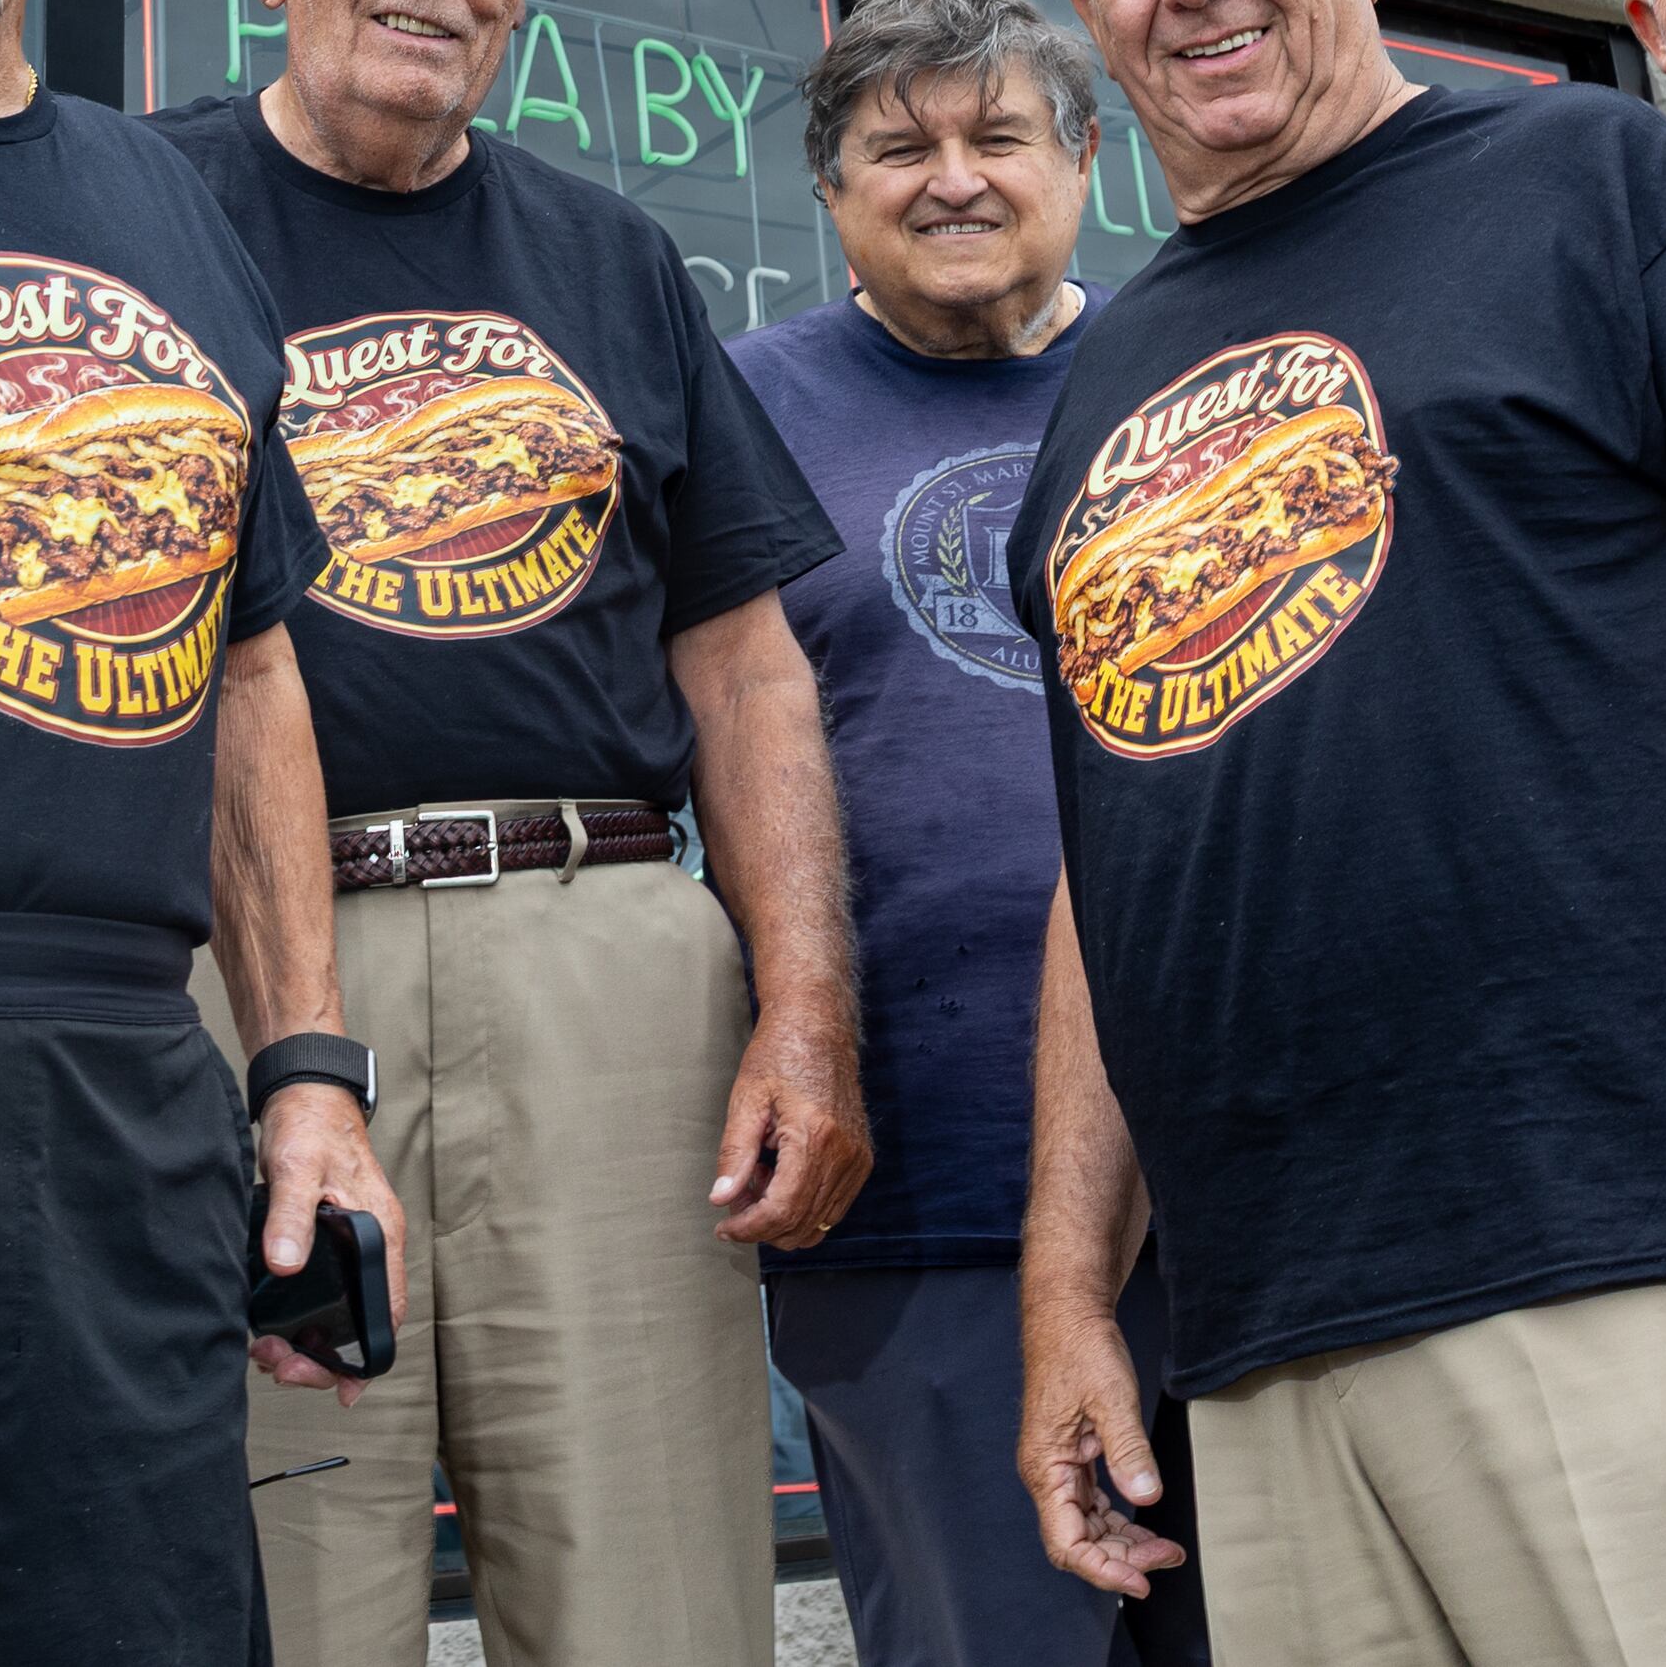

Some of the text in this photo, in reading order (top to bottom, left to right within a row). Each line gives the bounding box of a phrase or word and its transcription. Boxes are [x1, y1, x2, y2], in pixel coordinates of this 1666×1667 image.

[634, 37, 765, 177] BY
[89, 286, 211, 390] For
[445, 320, 553, 377] For
[1088, 343, 1348, 495] Quest For
[315, 507, 599, 617] THE ULTIMATE
[911, 496, 945, 566] MOUNT
[942, 481, 971, 499] ST.
[944, 603, 979, 627] 18
[1091, 562, 1361, 734] THE ULTIMATE
